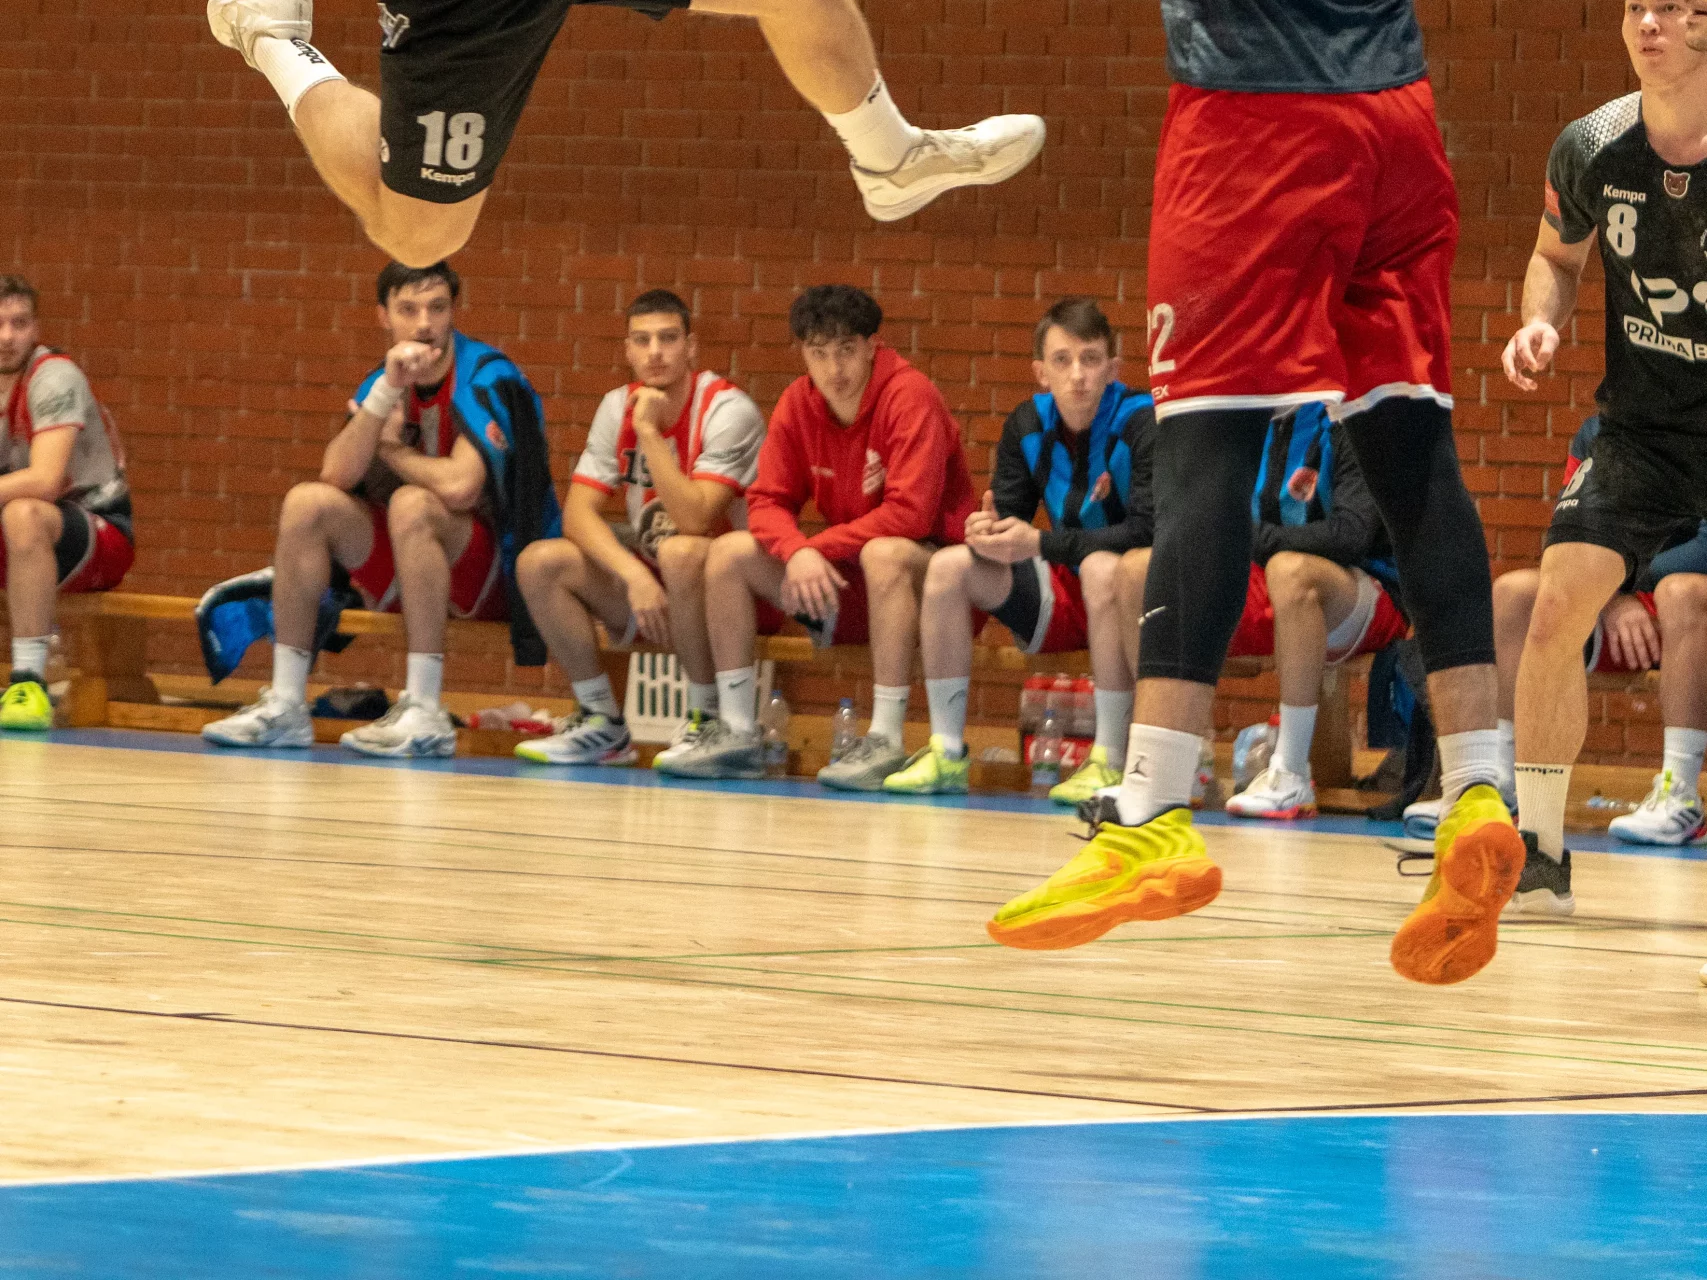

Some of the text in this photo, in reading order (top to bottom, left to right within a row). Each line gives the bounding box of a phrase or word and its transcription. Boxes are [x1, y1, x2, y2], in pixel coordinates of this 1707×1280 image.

[416, 110, 487, 170] 18
[420, 167, 477, 187] Kempa
[1603, 183, 1648, 203] Kempa
[1605, 203, 1638, 257] 8
